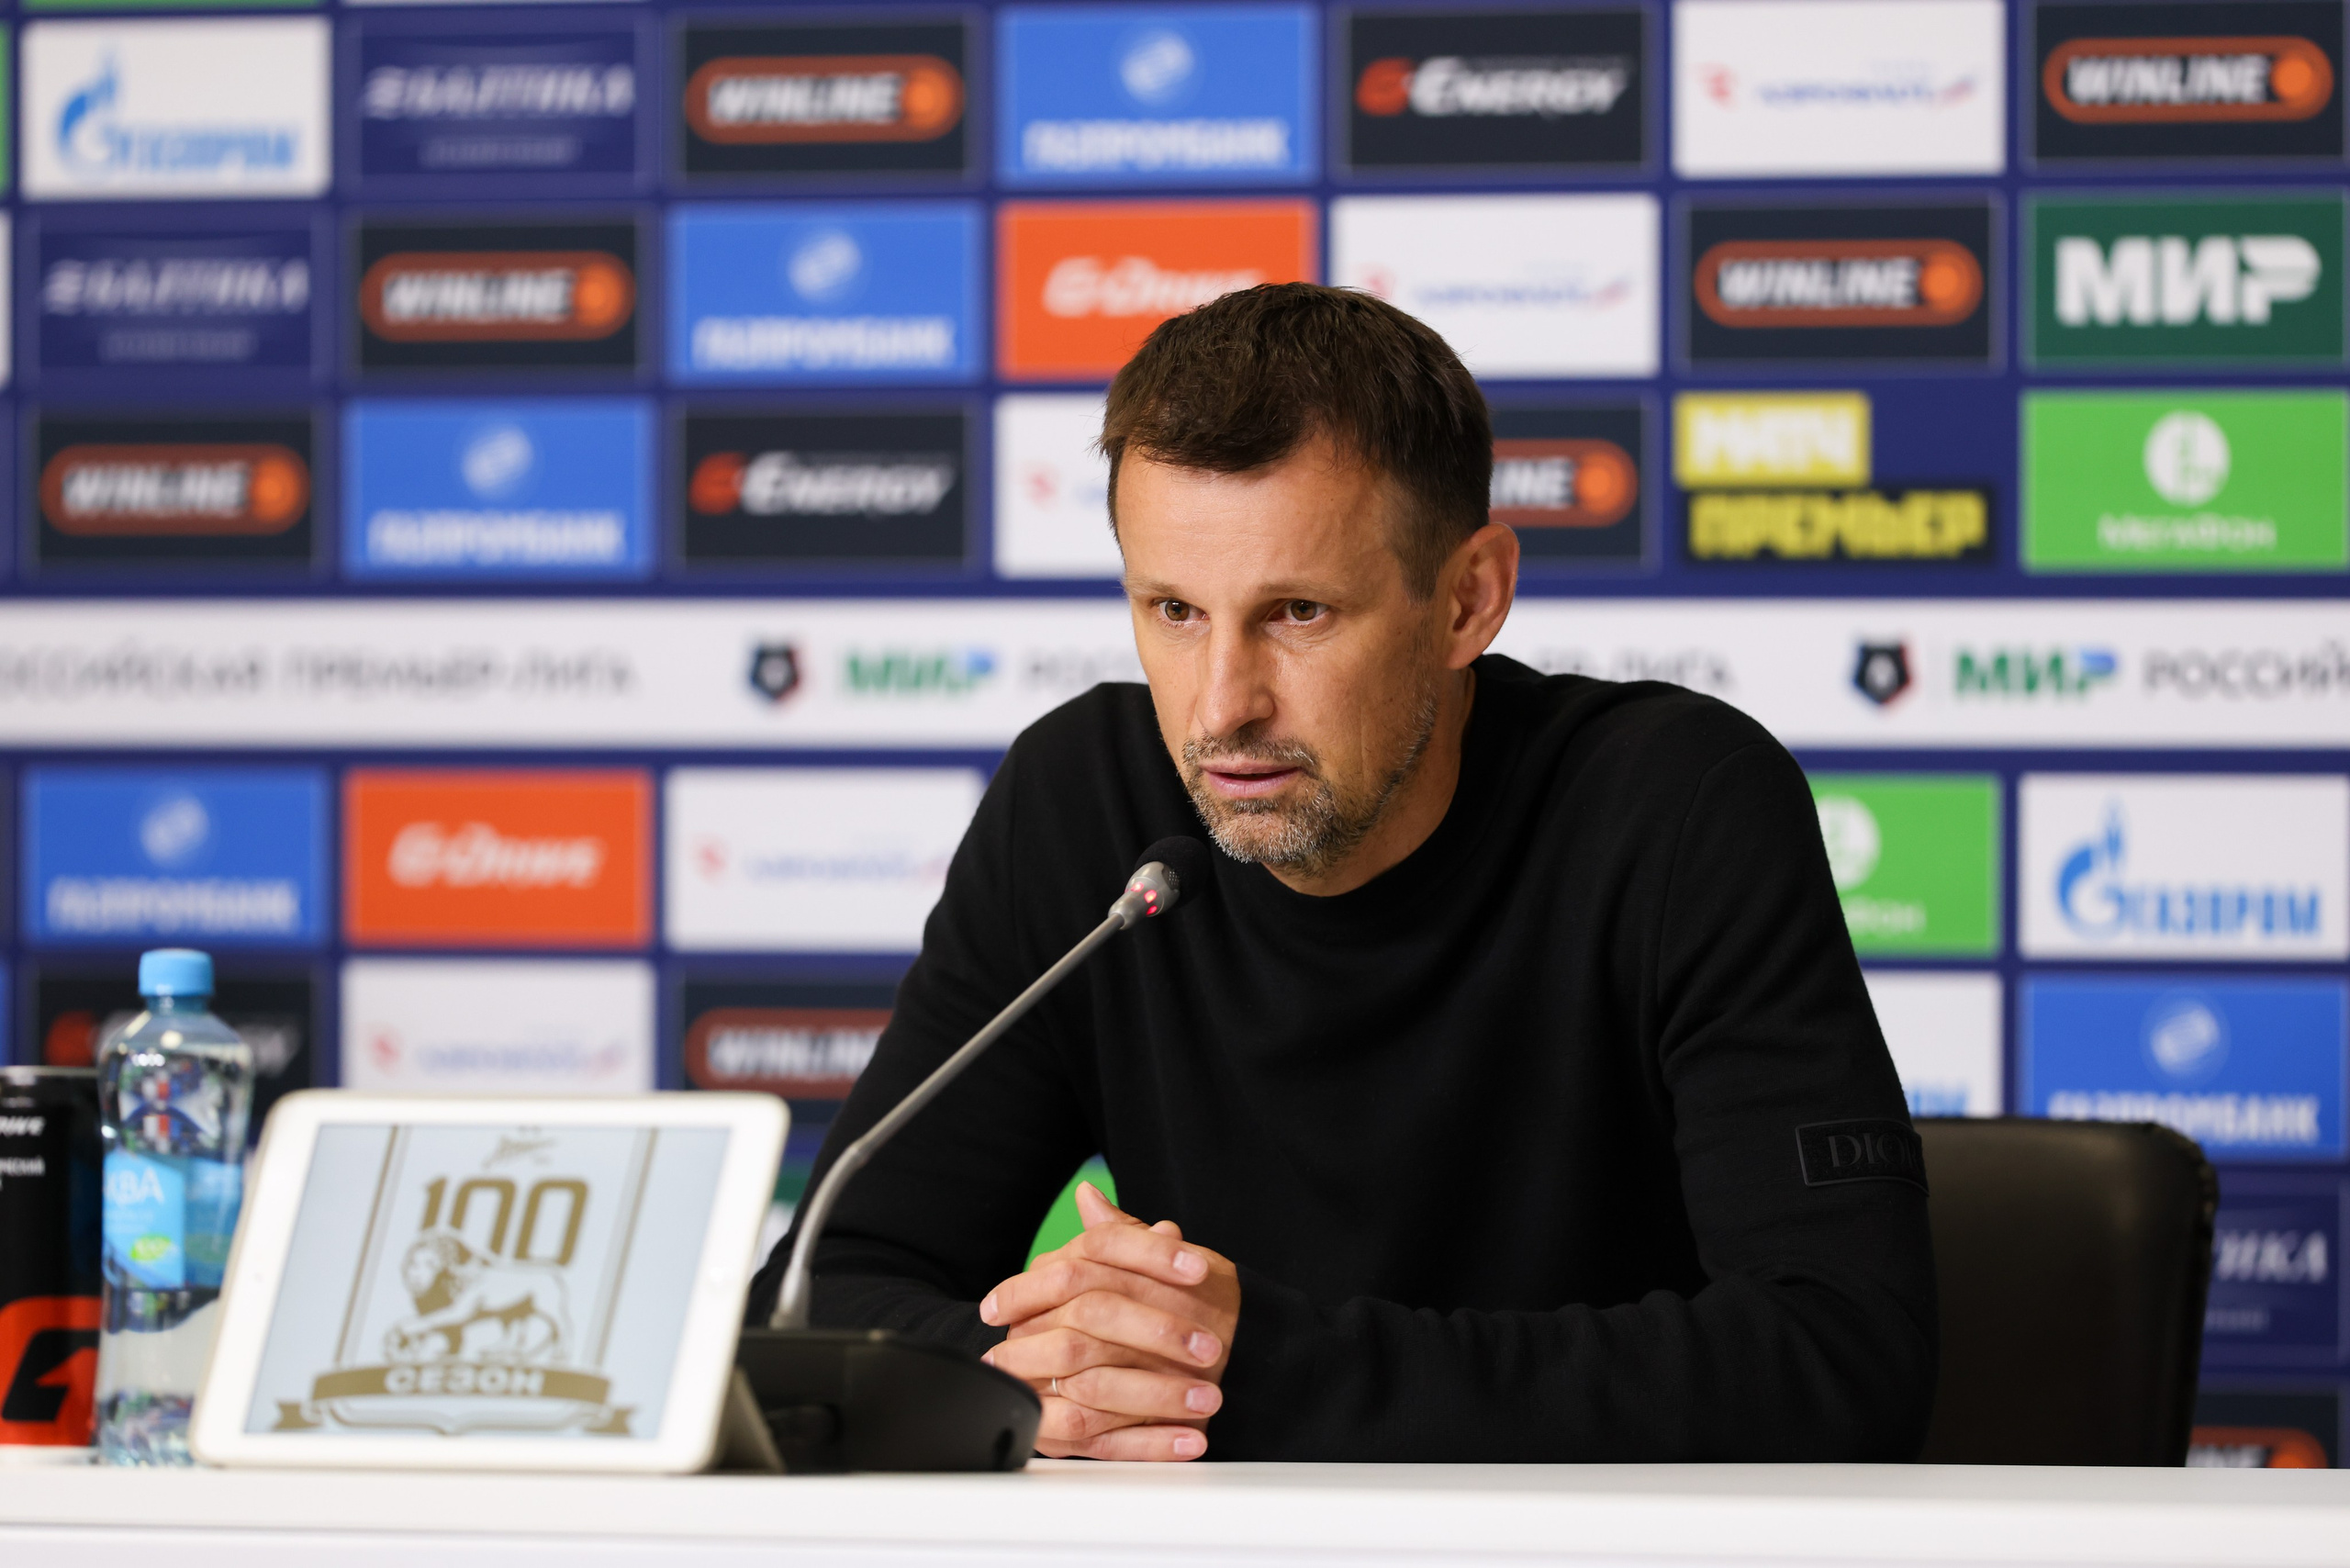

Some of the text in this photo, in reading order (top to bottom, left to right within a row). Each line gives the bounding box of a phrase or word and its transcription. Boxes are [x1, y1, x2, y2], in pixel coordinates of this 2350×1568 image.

[708, 73, 904, 126] WINLINE
[2066, 55, 2270, 106] WINLINE
[1022, 118, 1283, 173] ГАЗПРОМБАНК
[383, 268, 573, 325] WINLINE
[1717, 258, 1922, 310] WINLINE
[2053, 234, 2322, 327] МИР
[692, 316, 955, 369] ГАЗПРОМБАНК
[1689, 404, 1858, 476] МАТЧ
[62, 463, 250, 520] WINLINE
[365, 508, 628, 566] ГАЗПРОМБАНК
[1687, 490, 1987, 560] ПРЕМЬЕР
[0, 636, 262, 703] ОССИЙСКАЯ
[842, 647, 996, 699] МИР
[1953, 637, 2350, 701] МИР РОССИЙ
[707, 1025, 885, 1083] WINLIN
[420, 1175, 589, 1268] 100
[385, 1363, 546, 1397] СЕЗОН
